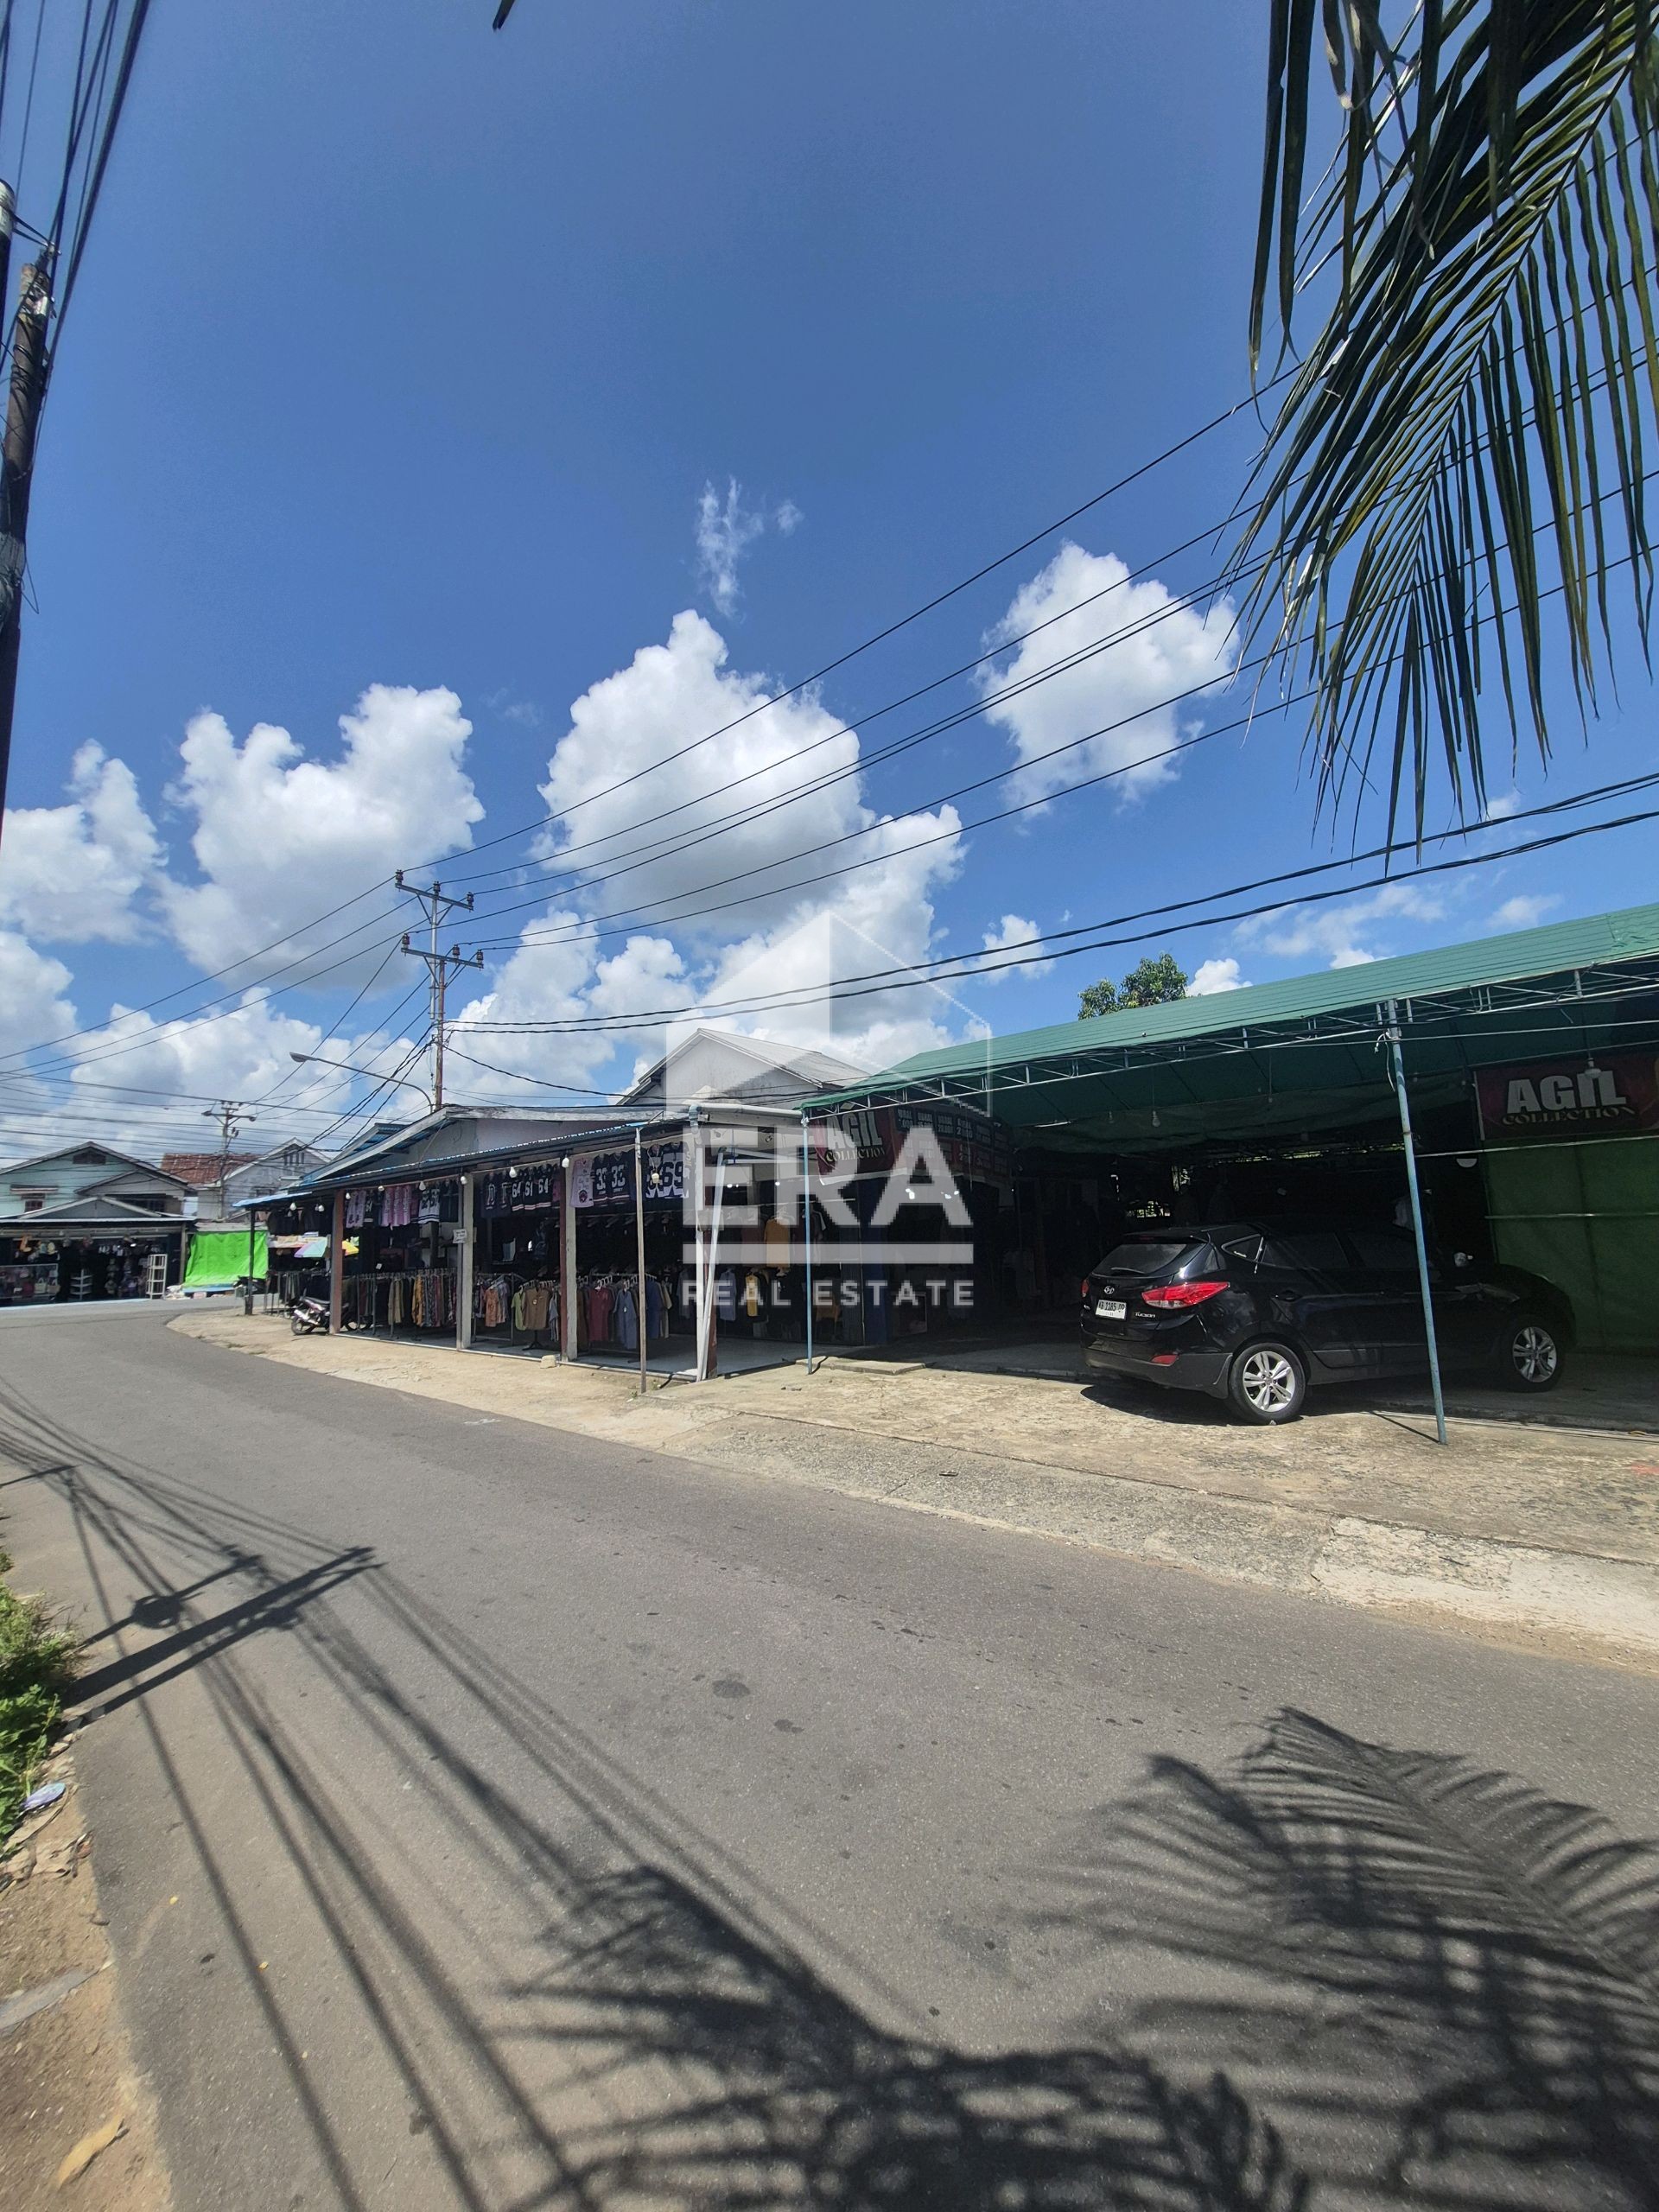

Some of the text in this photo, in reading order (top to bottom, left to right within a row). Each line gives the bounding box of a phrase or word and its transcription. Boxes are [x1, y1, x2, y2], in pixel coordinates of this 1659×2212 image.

[1507, 1070, 1627, 1115] AGIL
[1502, 1105, 1636, 1126] COLLECTION
[826, 1110, 883, 1150] AGIL
[826, 1146, 886, 1163] COLLECTION
[663, 1161, 683, 1187] 69
